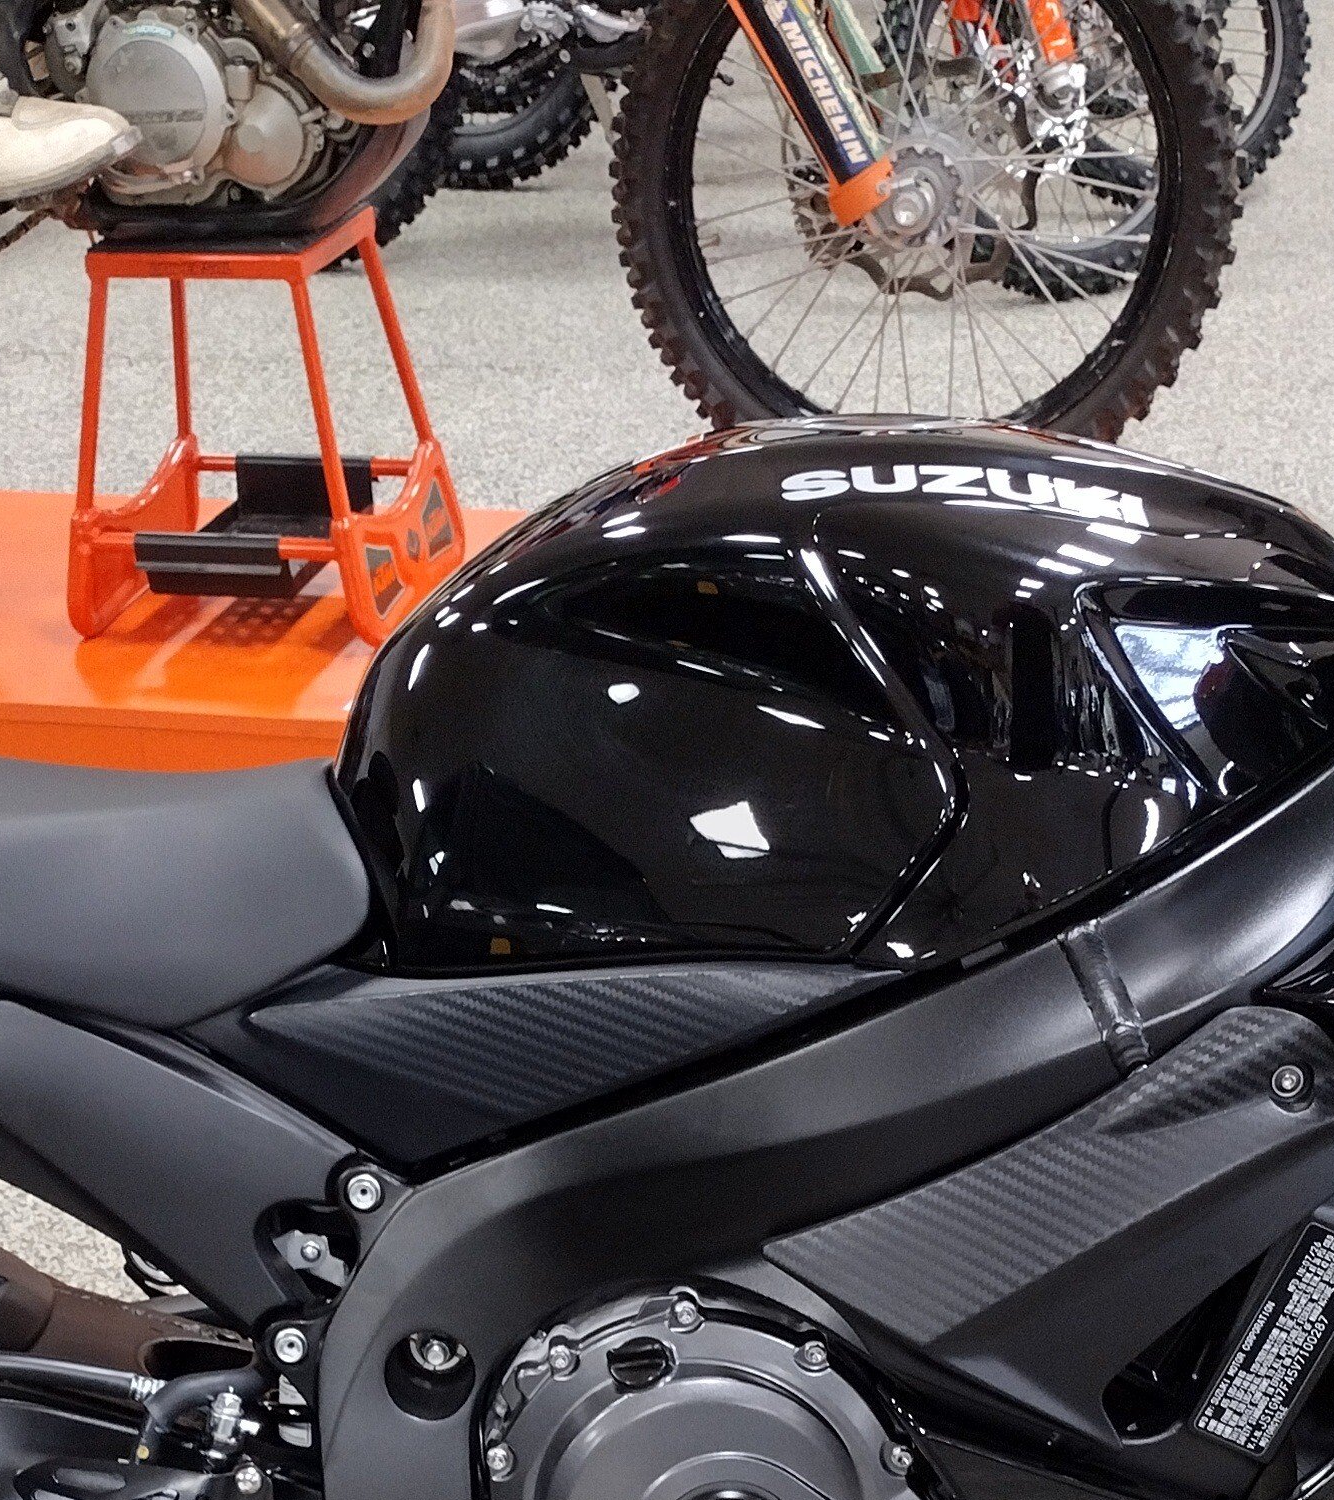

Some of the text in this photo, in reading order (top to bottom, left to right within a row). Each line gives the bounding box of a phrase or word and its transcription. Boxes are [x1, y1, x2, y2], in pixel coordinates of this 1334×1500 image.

[781, 21, 868, 164] MICHELIN
[781, 464, 1149, 527] SUZUKI
[1209, 1376, 1231, 1406] SUZUKI
[1225, 1350, 1247, 1378] MOTOR
[1240, 1298, 1276, 1352] CORPORATION
